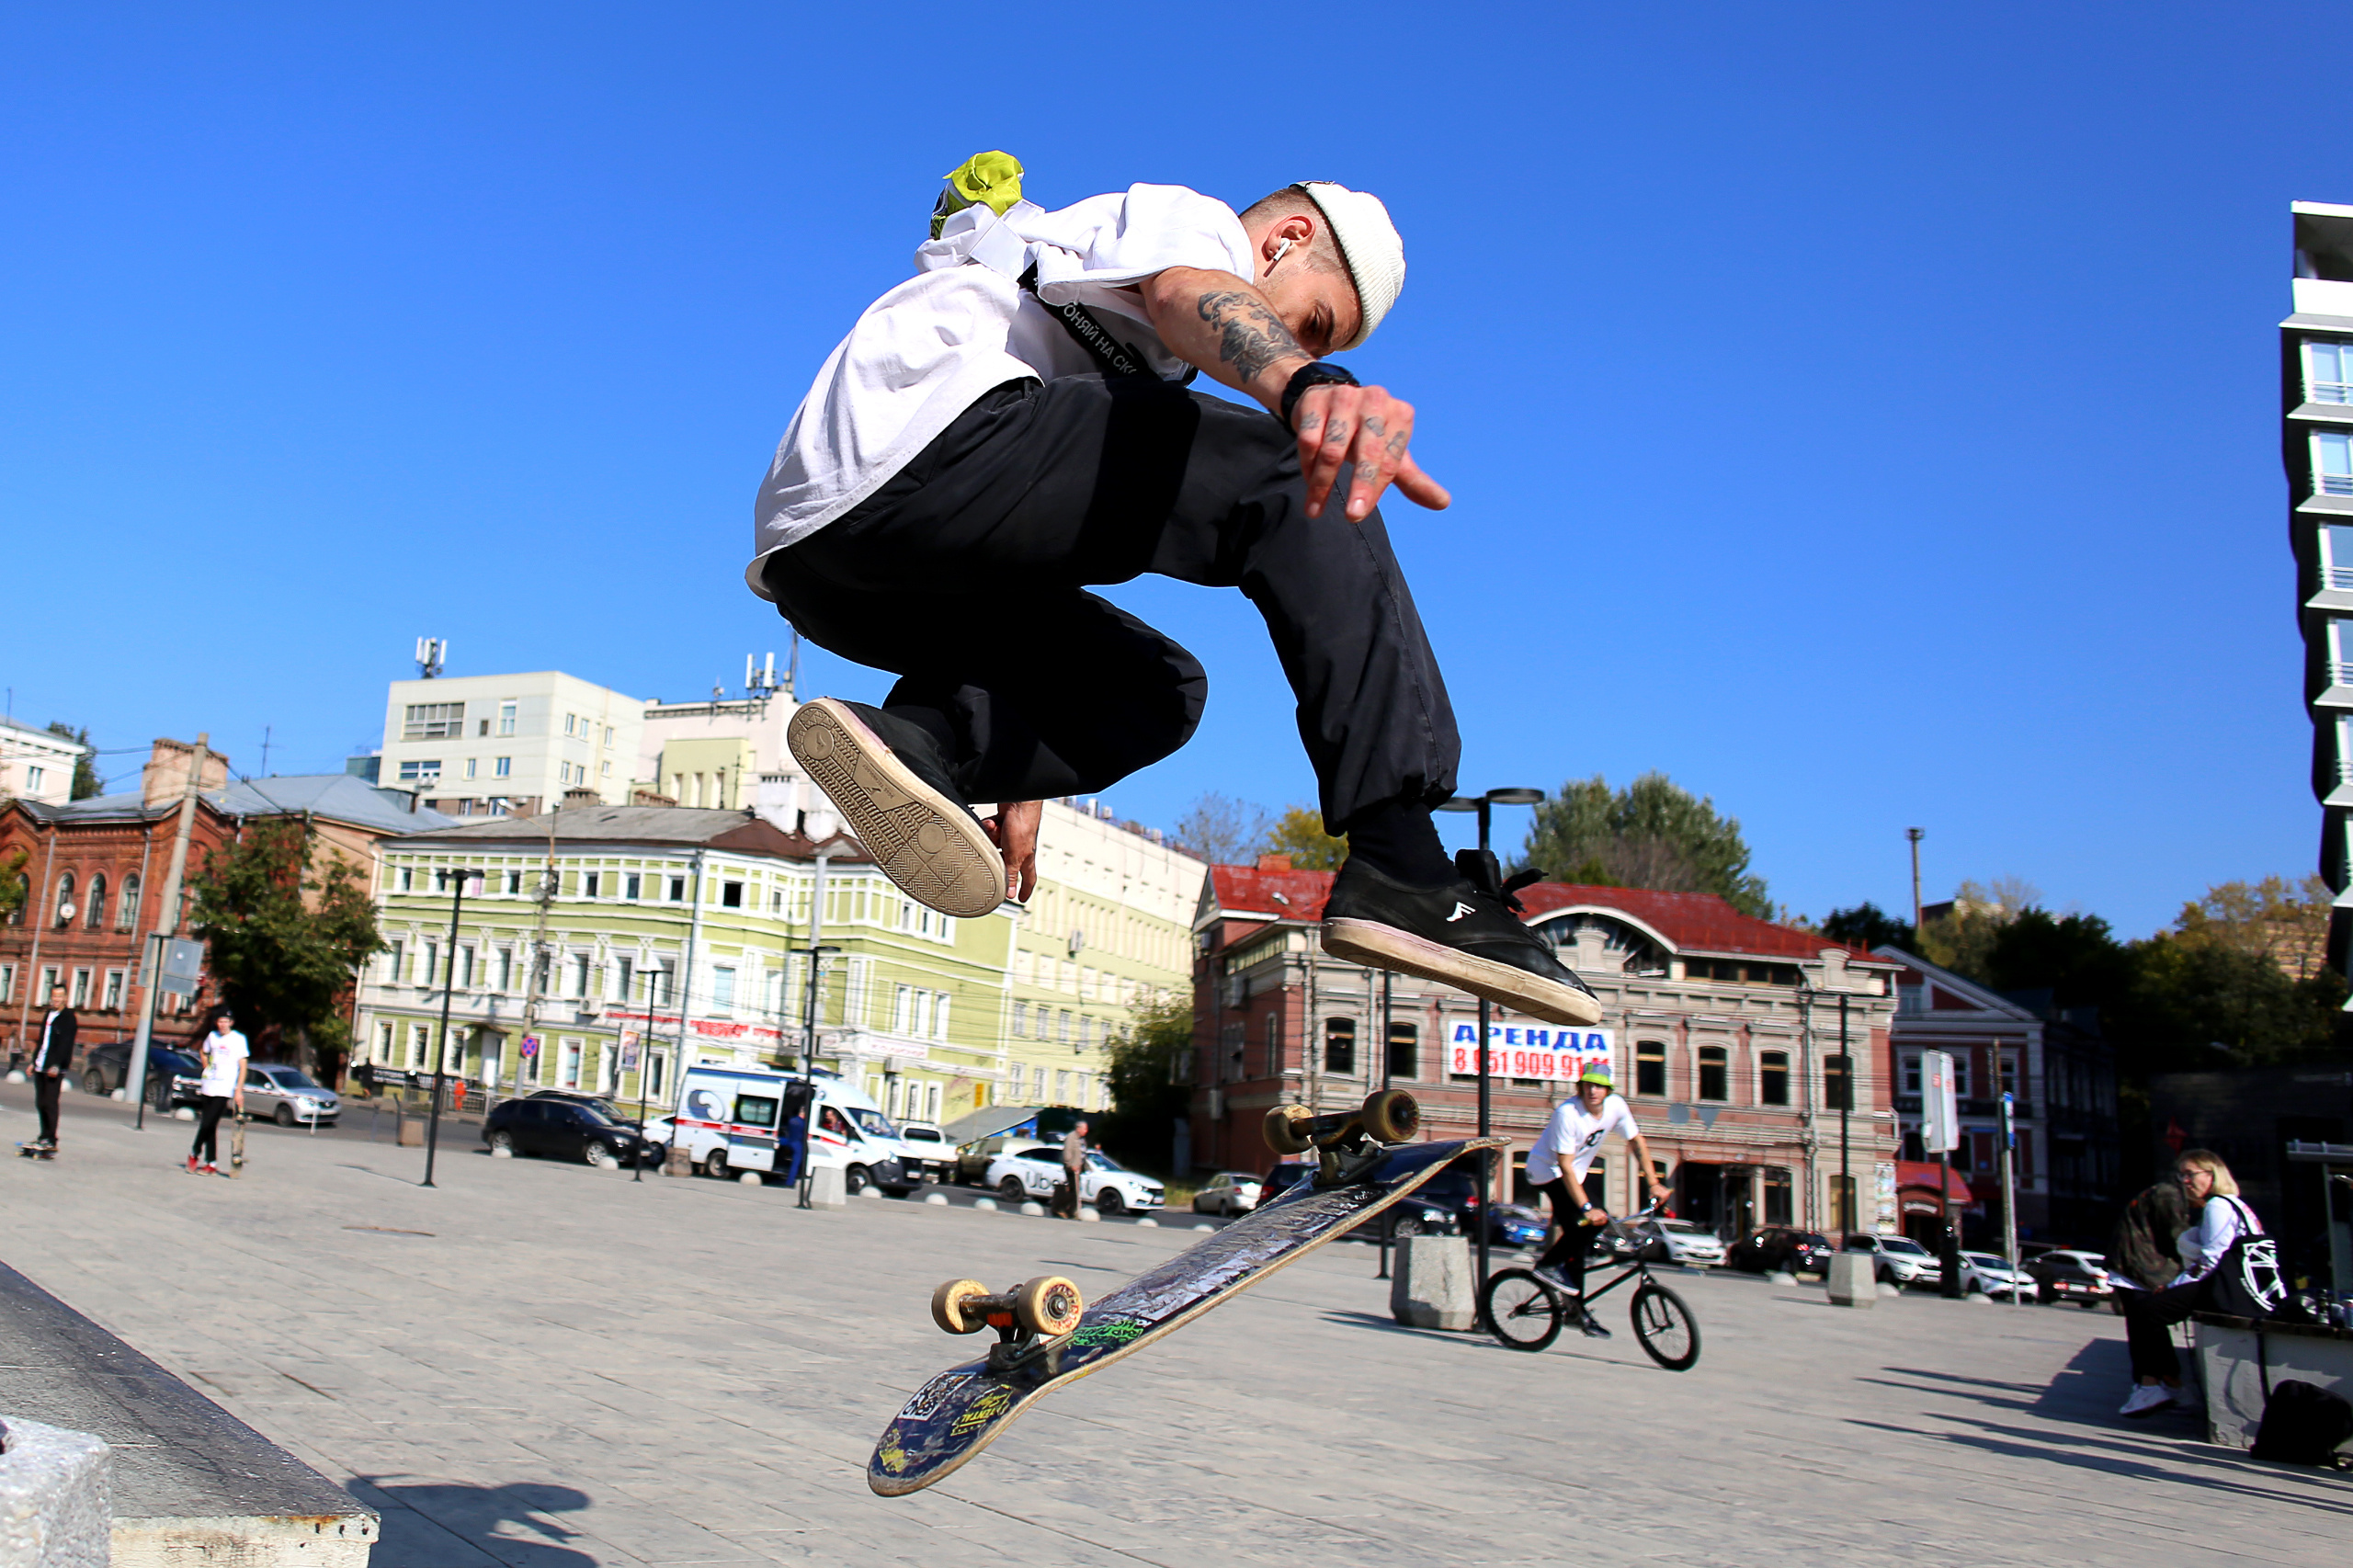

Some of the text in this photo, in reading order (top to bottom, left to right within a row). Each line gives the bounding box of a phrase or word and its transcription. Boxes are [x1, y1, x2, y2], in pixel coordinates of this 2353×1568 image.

[1063, 304, 1099, 341] ОНЯЙ
[1095, 336, 1115, 359] НА
[1454, 1025, 1608, 1051] АРЕНДА
[1455, 1048, 1466, 1072] 8
[1515, 1051, 1555, 1078] 909
